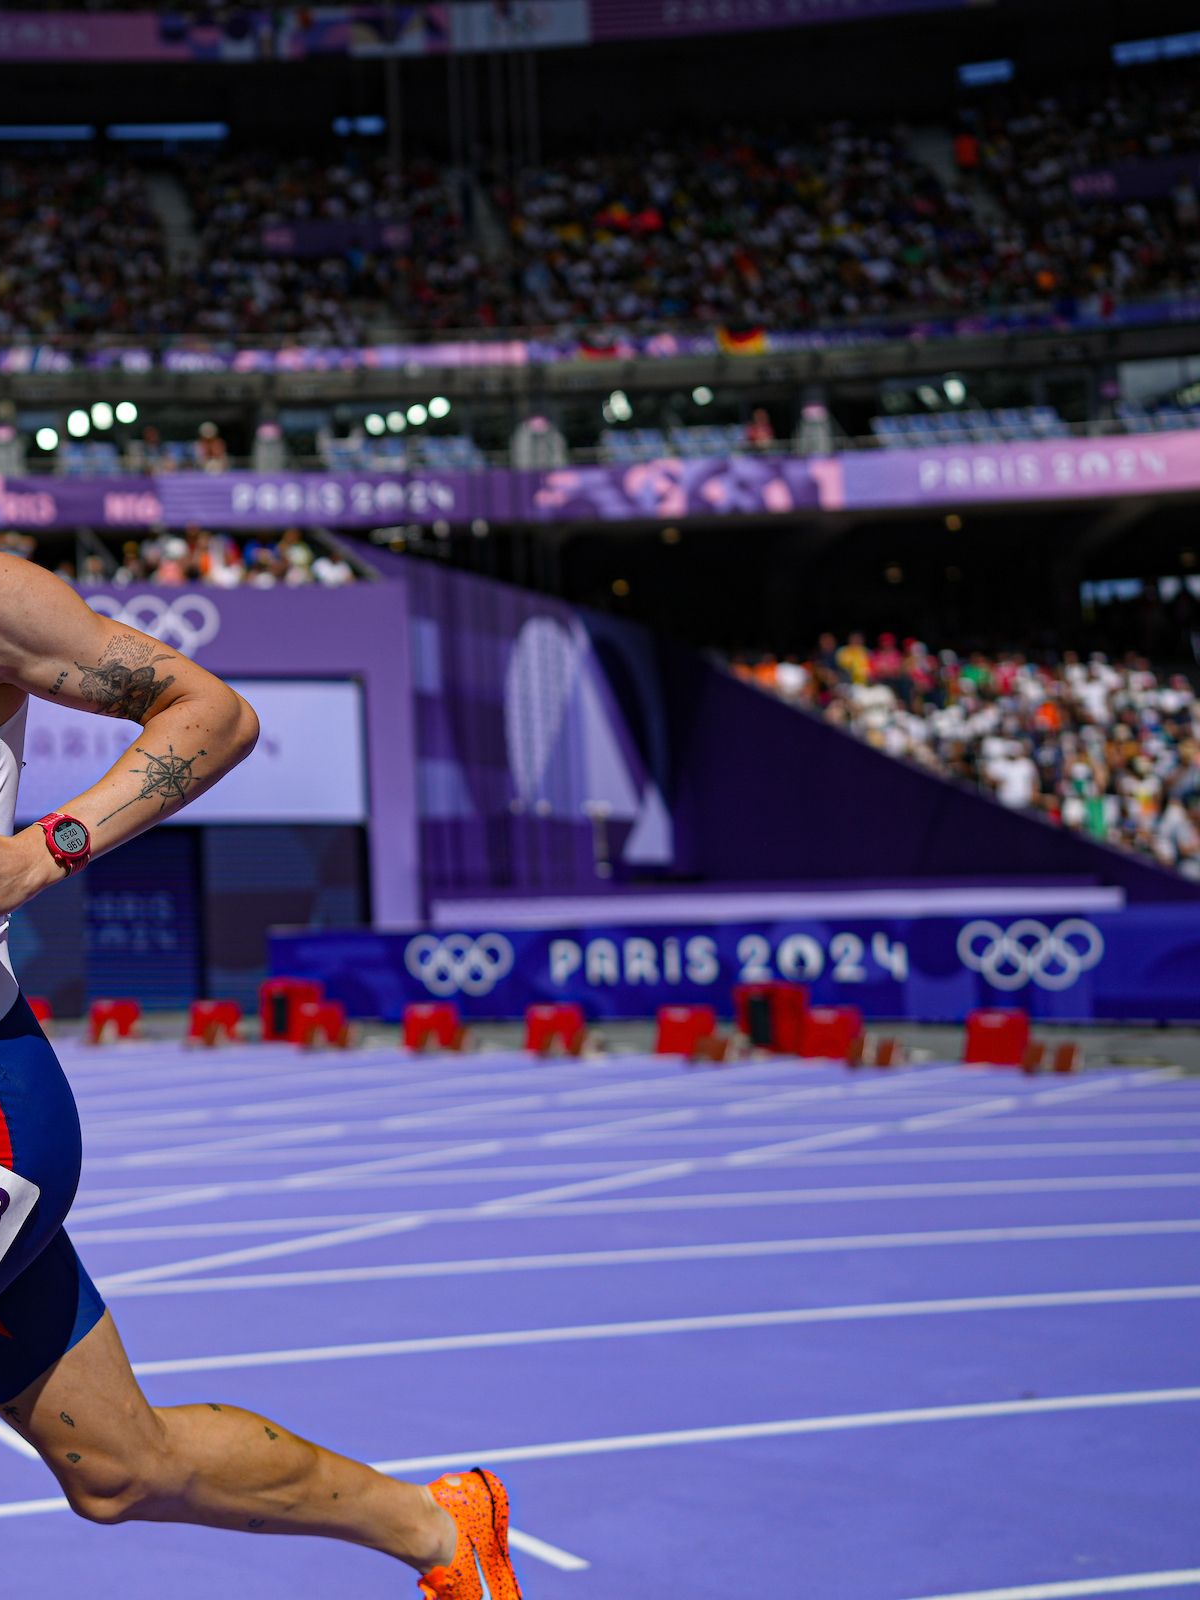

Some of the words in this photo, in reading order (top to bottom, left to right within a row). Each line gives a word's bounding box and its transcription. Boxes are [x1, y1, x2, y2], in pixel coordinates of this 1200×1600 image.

[1051, 448, 1167, 486] 2024
[350, 480, 455, 516] 2024
[736, 931, 908, 985] 2024
